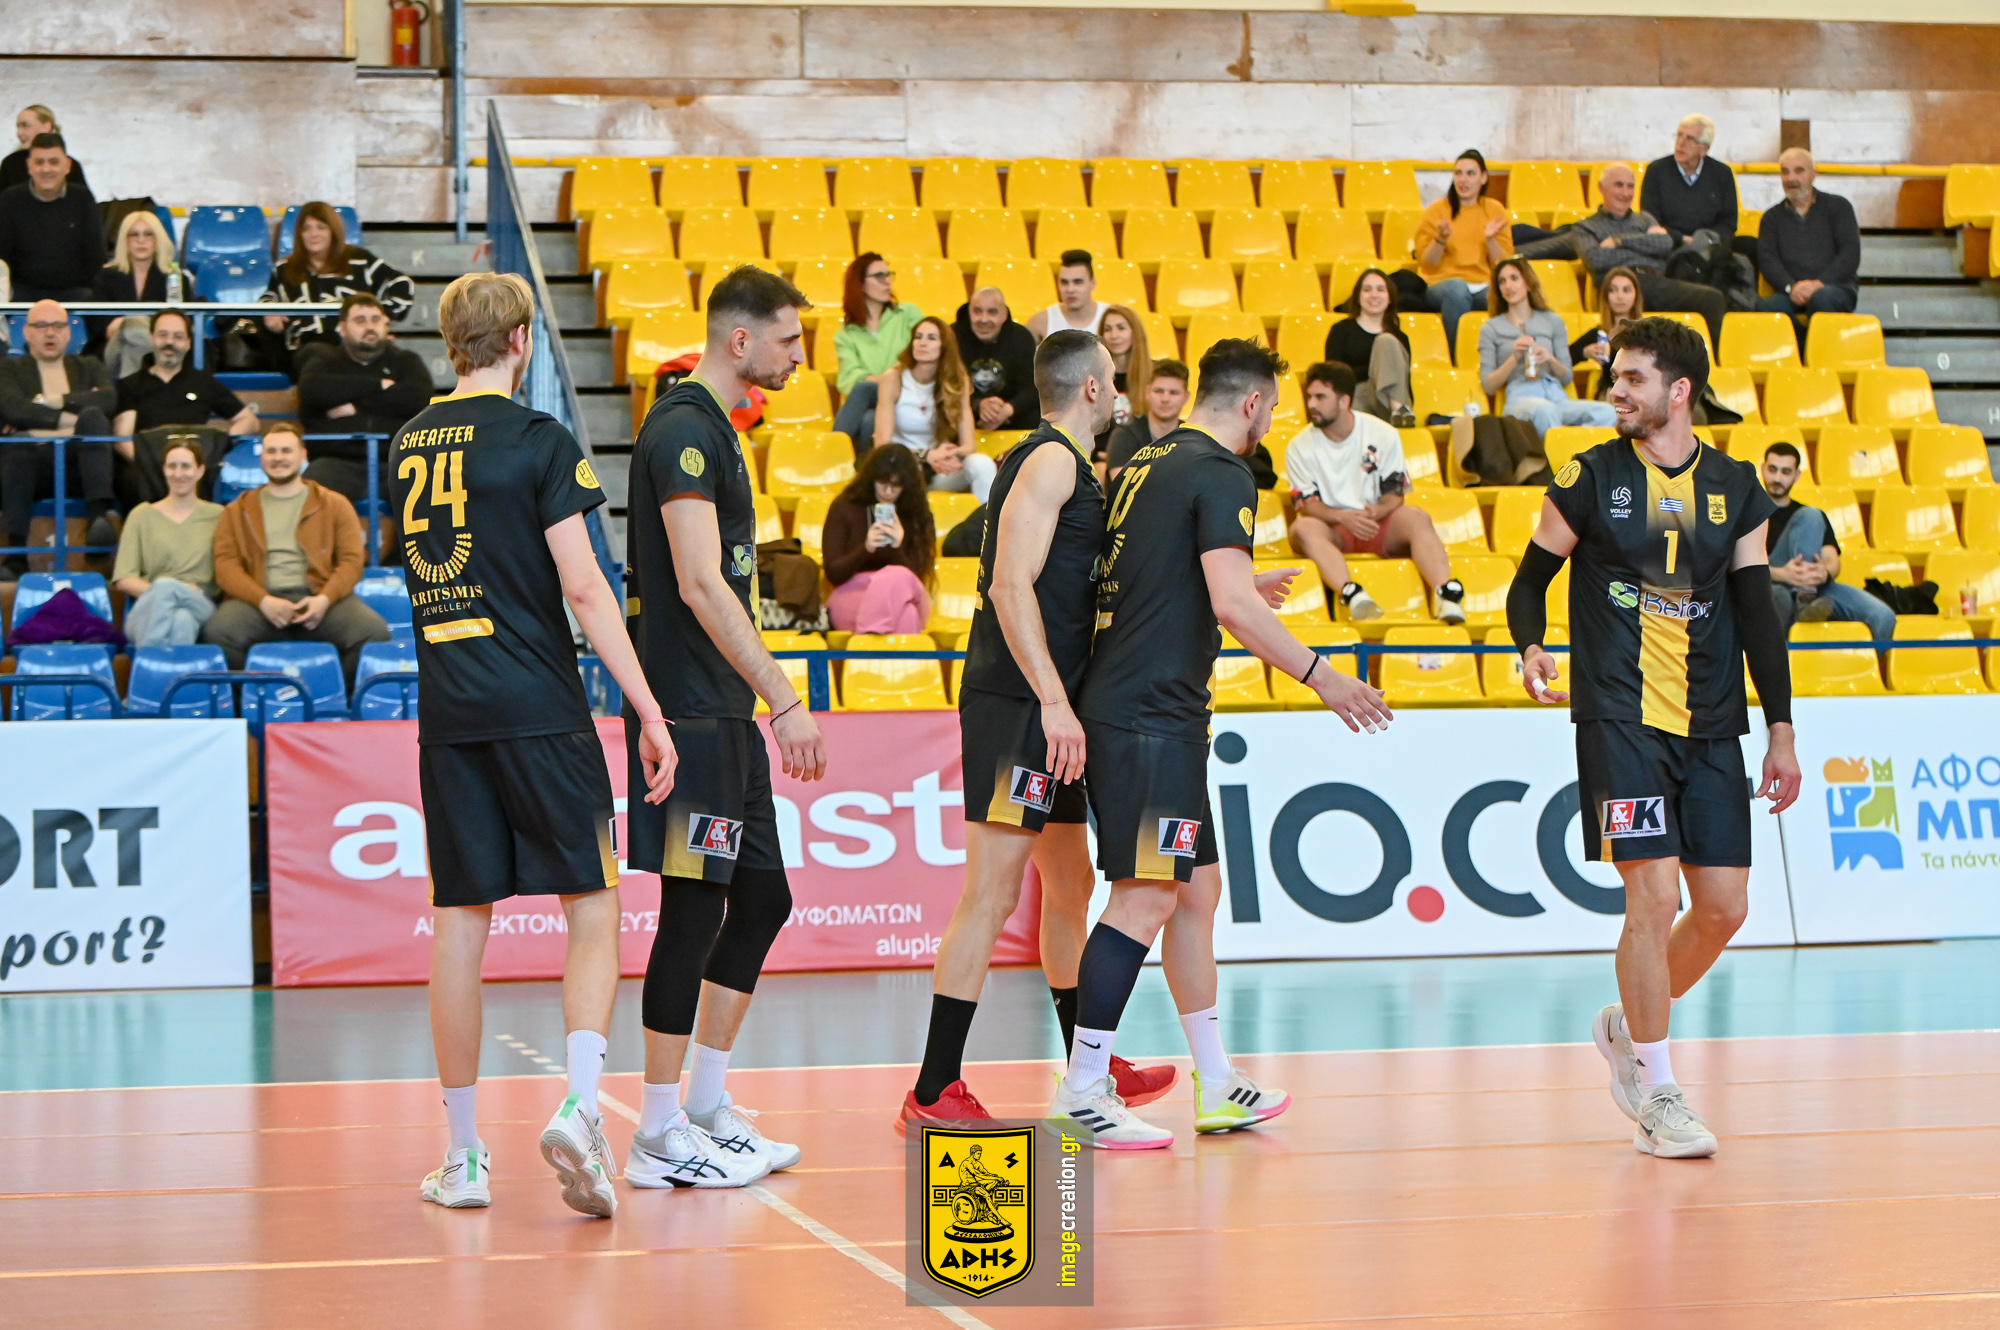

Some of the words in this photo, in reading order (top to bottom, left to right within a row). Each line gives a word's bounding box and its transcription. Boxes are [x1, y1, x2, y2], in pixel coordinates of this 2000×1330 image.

[400, 425, 474, 450] SHEAFFER
[398, 451, 468, 535] 24
[1106, 464, 1152, 532] 13
[1664, 530, 1679, 574] 1
[411, 585, 483, 607] KRITSIMIS
[422, 601, 471, 616] JEWELLERY
[1604, 798, 1663, 833] I&K
[690, 816, 743, 853] I&K
[1161, 819, 1200, 851] I&
[1921, 852, 1945, 869] Τα
[1951, 851, 2000, 869] πάντ
[875, 932, 943, 960] alupla
